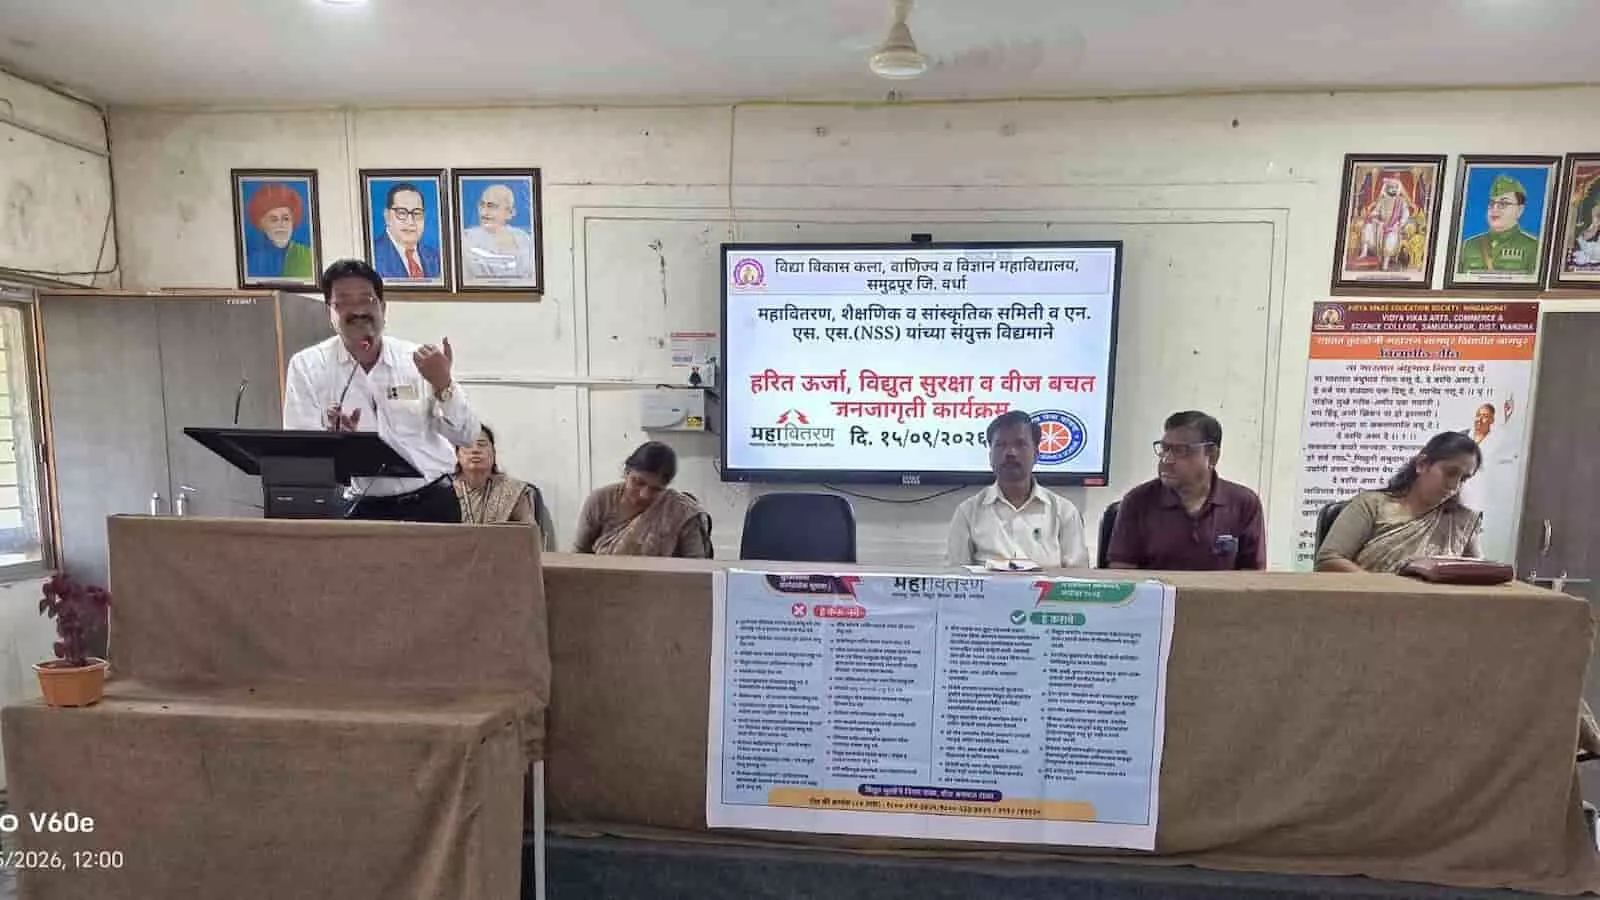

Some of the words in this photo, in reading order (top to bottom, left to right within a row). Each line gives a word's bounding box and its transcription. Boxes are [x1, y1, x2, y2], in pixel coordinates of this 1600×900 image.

[775, 257, 804, 273] विद्या
[809, 257, 849, 273] विकास
[854, 261, 886, 274] कला,
[890, 257, 939, 273] वाणिज्य
[943, 260, 953, 272] व
[956, 256, 995, 273] विज्ञान
[866, 278, 913, 294] समुद्रपूर
[917, 274, 937, 291] जि.
[942, 274, 968, 291] वर्धा
[757, 303, 836, 323] महावितरण,
[906, 307, 917, 321] व
[921, 303, 993, 325] सांस्कृतिक
[997, 302, 1044, 321] समिती
[1048, 306, 1060, 321] व
[1064, 306, 1092, 323] एन.
[792, 327, 820, 342] एस.
[906, 323, 945, 340] यांच्या
[951, 323, 992, 345] संयुक्त
[996, 321, 1055, 340] विद्यमाने
[750, 368, 796, 394] हरित
[800, 368, 852, 395] ऊर्जा,
[859, 368, 914, 397] विद्युत
[919, 375, 973, 398] सुरक्षा
[980, 375, 995, 393] व
[1000, 369, 1043, 393] वीज
[1048, 375, 1097, 393] बचत
[830, 396, 927, 424] जनजागृती
[751, 422, 835, 442] महावितरण
[850, 425, 873, 447] दि.
[880, 429, 988, 449] १५/०९/२०२६
